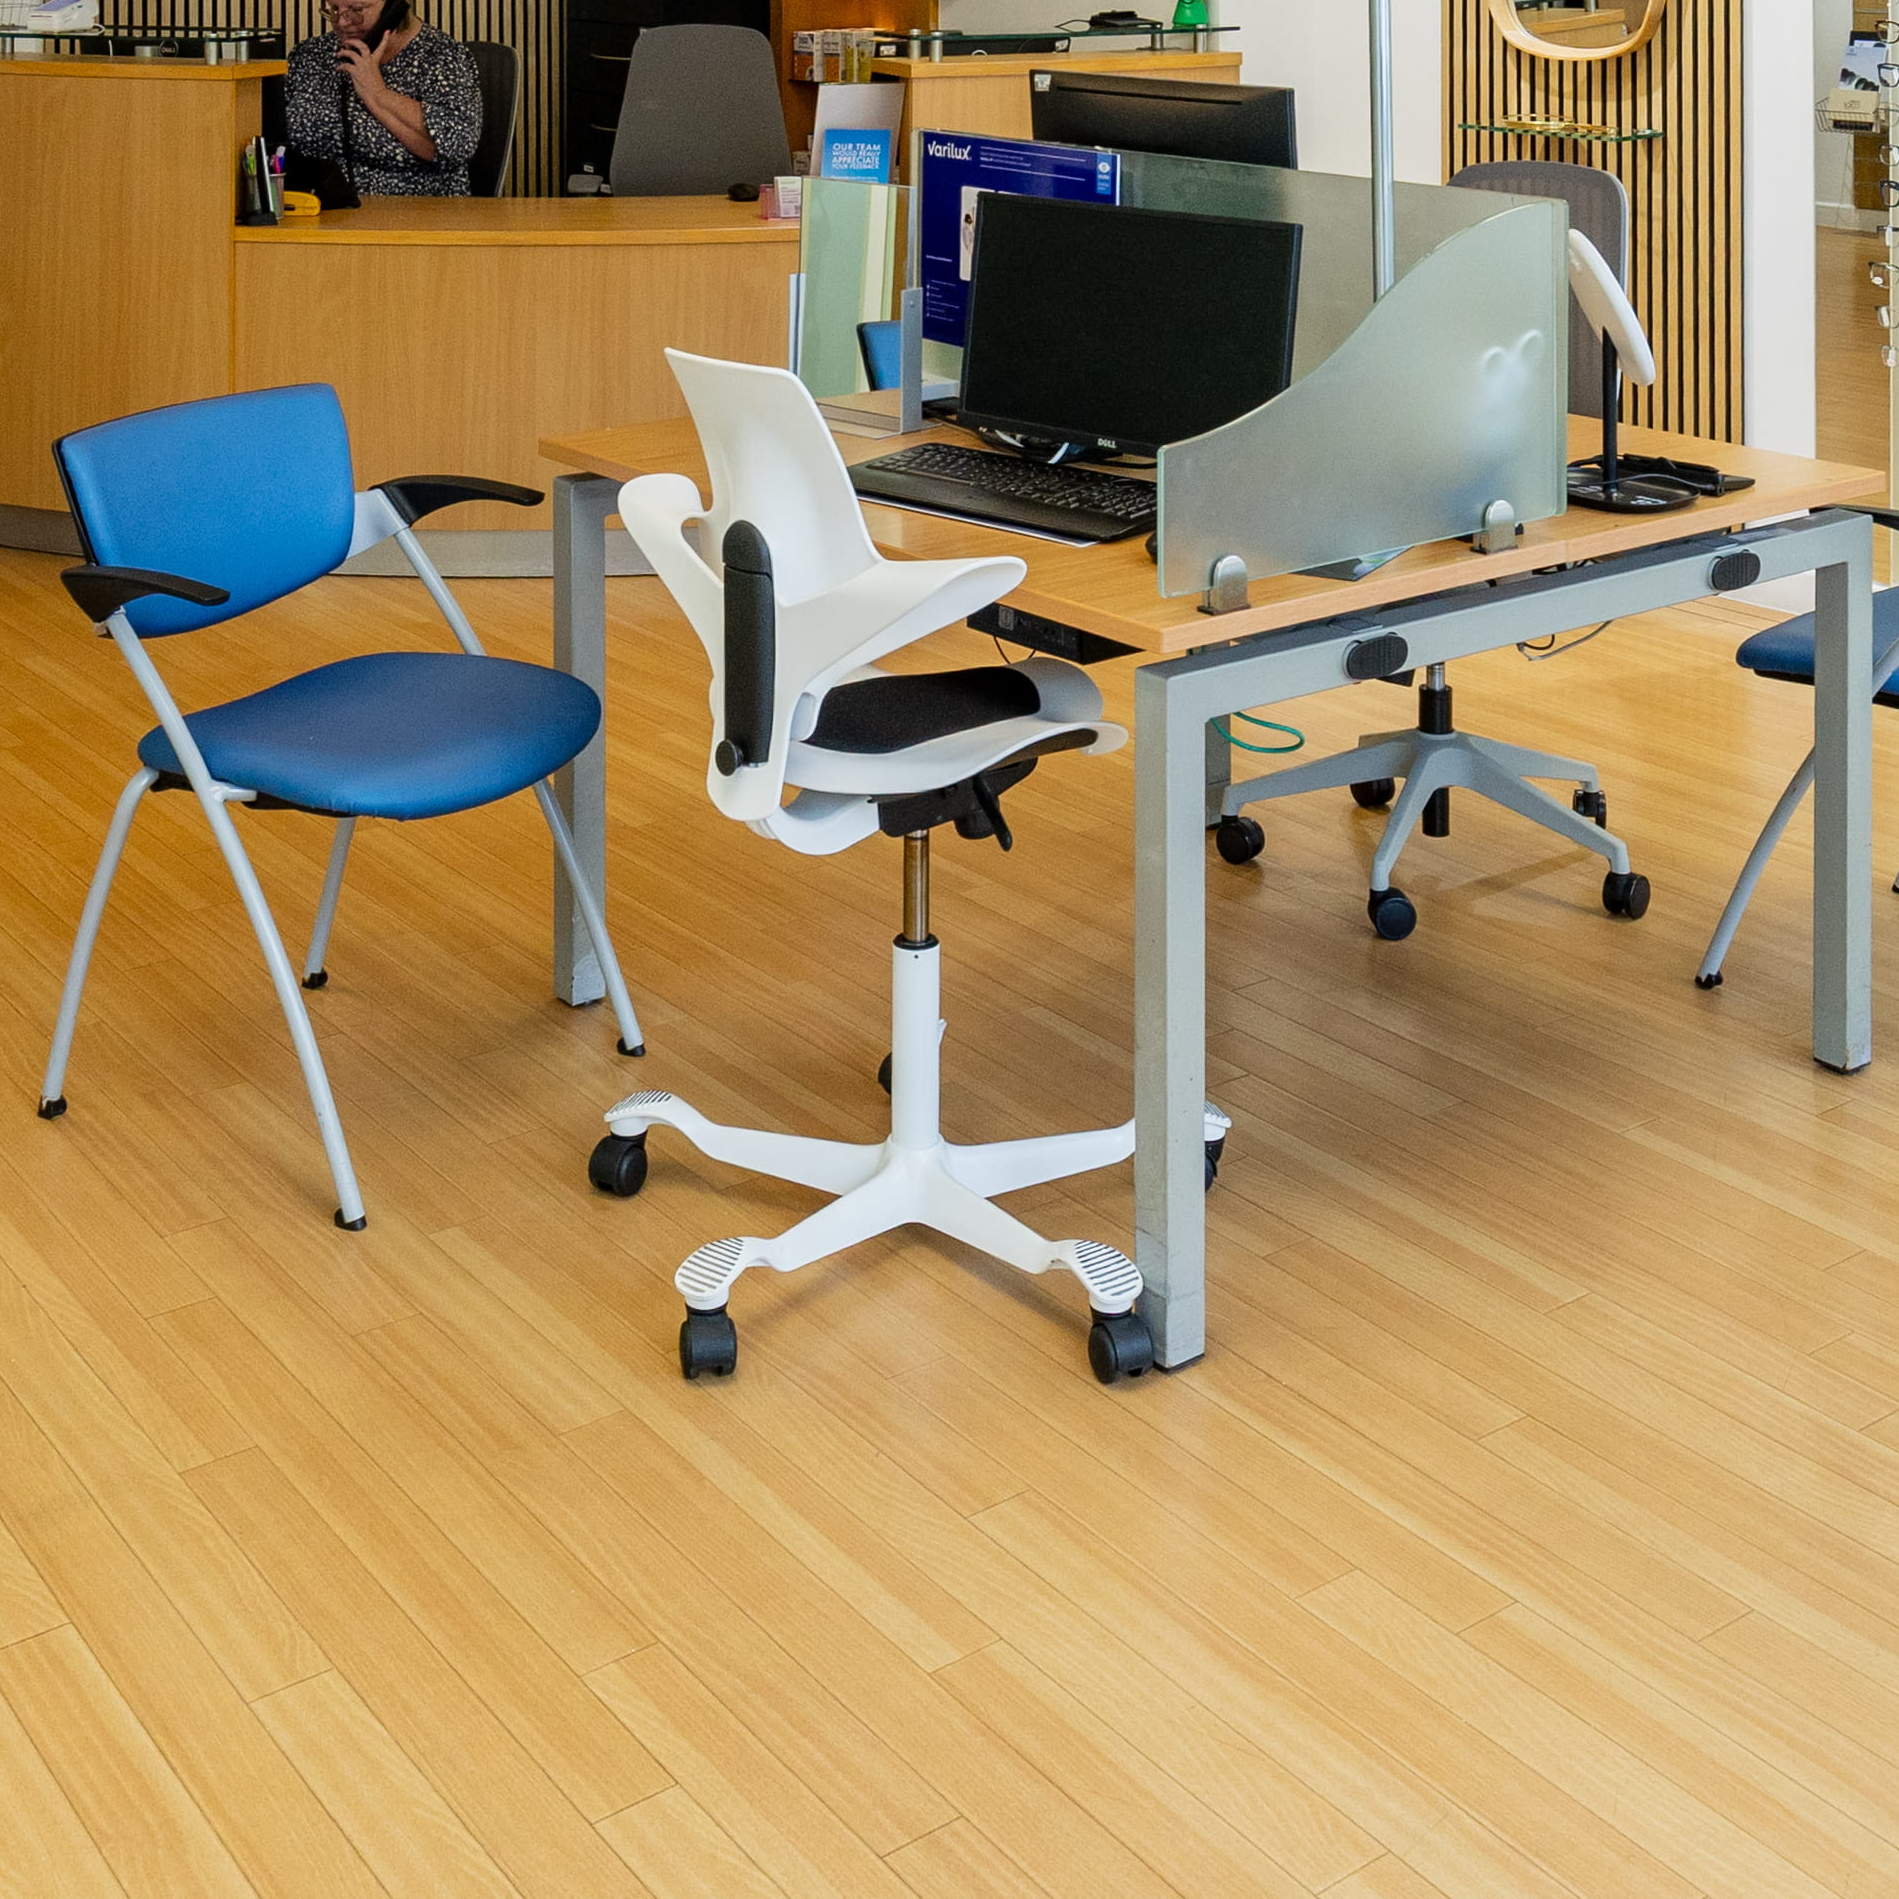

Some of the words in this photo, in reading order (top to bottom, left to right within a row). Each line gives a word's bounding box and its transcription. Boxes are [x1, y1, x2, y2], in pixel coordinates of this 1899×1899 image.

[832, 142, 854, 150] OUR
[856, 142, 881, 151] TEAM
[832, 156, 880, 164] APPRECIATE
[1097, 437, 1117, 449] DELL
